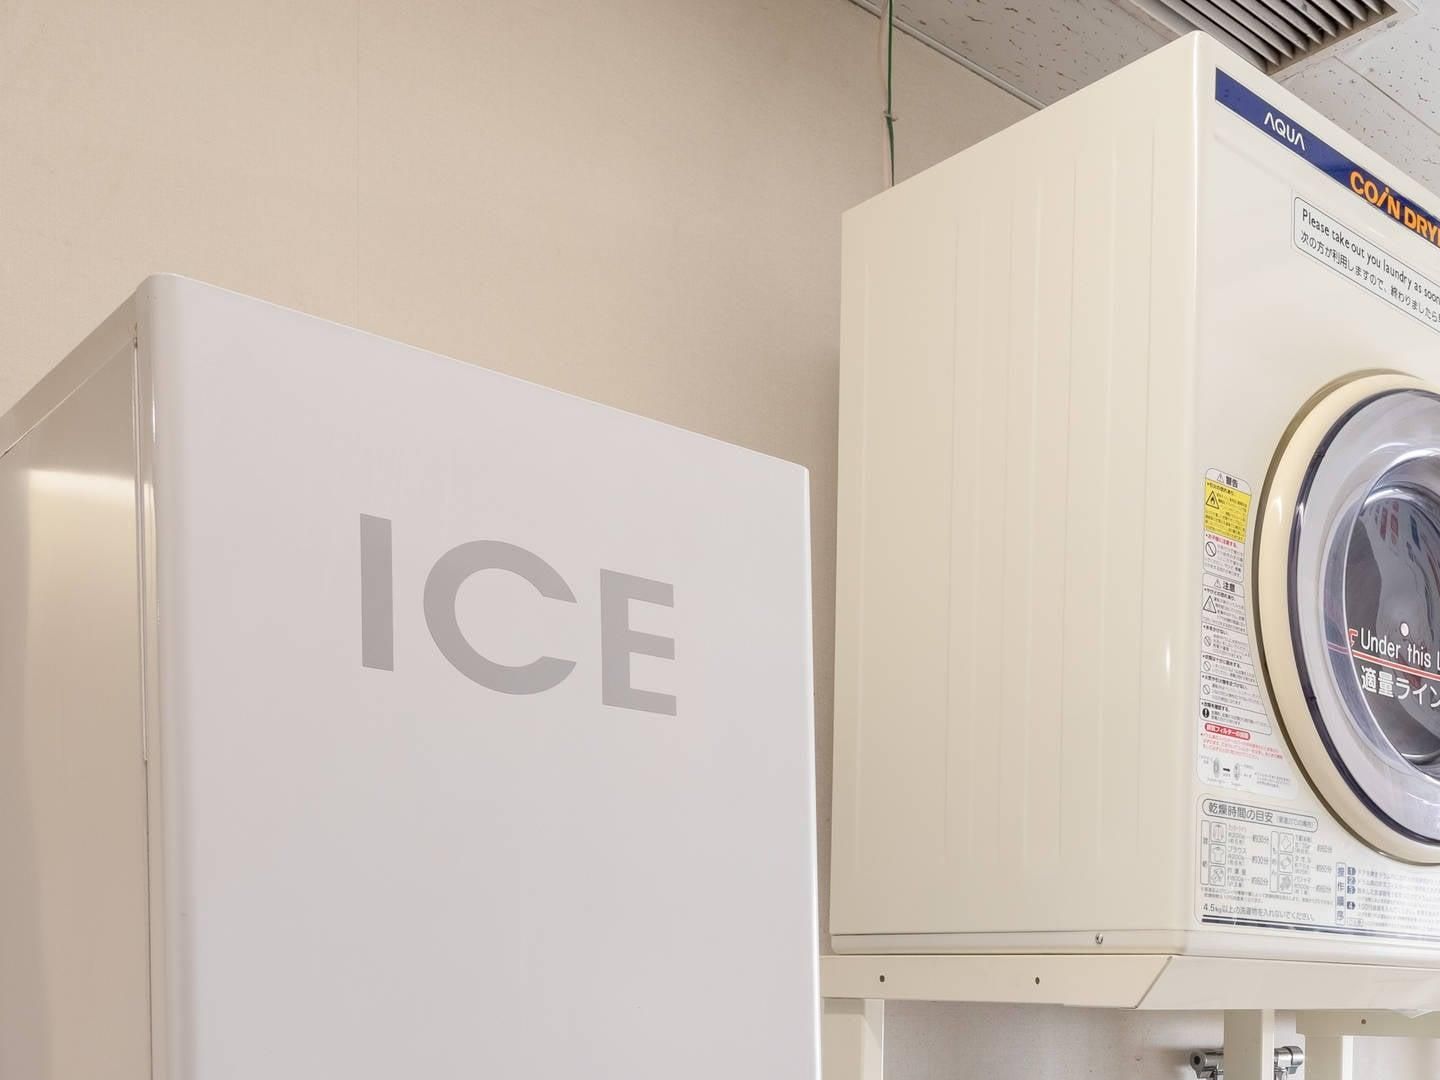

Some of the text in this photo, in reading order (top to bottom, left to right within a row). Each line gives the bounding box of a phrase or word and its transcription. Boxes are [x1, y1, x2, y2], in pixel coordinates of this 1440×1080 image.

[1264, 112, 1306, 150] AQUA
[1350, 171, 1400, 220] COIN
[1302, 208, 1329, 236] Please
[1332, 230, 1350, 249] take
[1351, 243, 1365, 258] out
[1367, 252, 1381, 268] you
[1383, 259, 1412, 290] laundry
[1414, 282, 1422, 294] as
[1424, 288, 1440, 305] soon
[360, 513, 677, 716] ICE
[1361, 627, 1401, 659] Under
[1407, 643, 1432, 668] this
